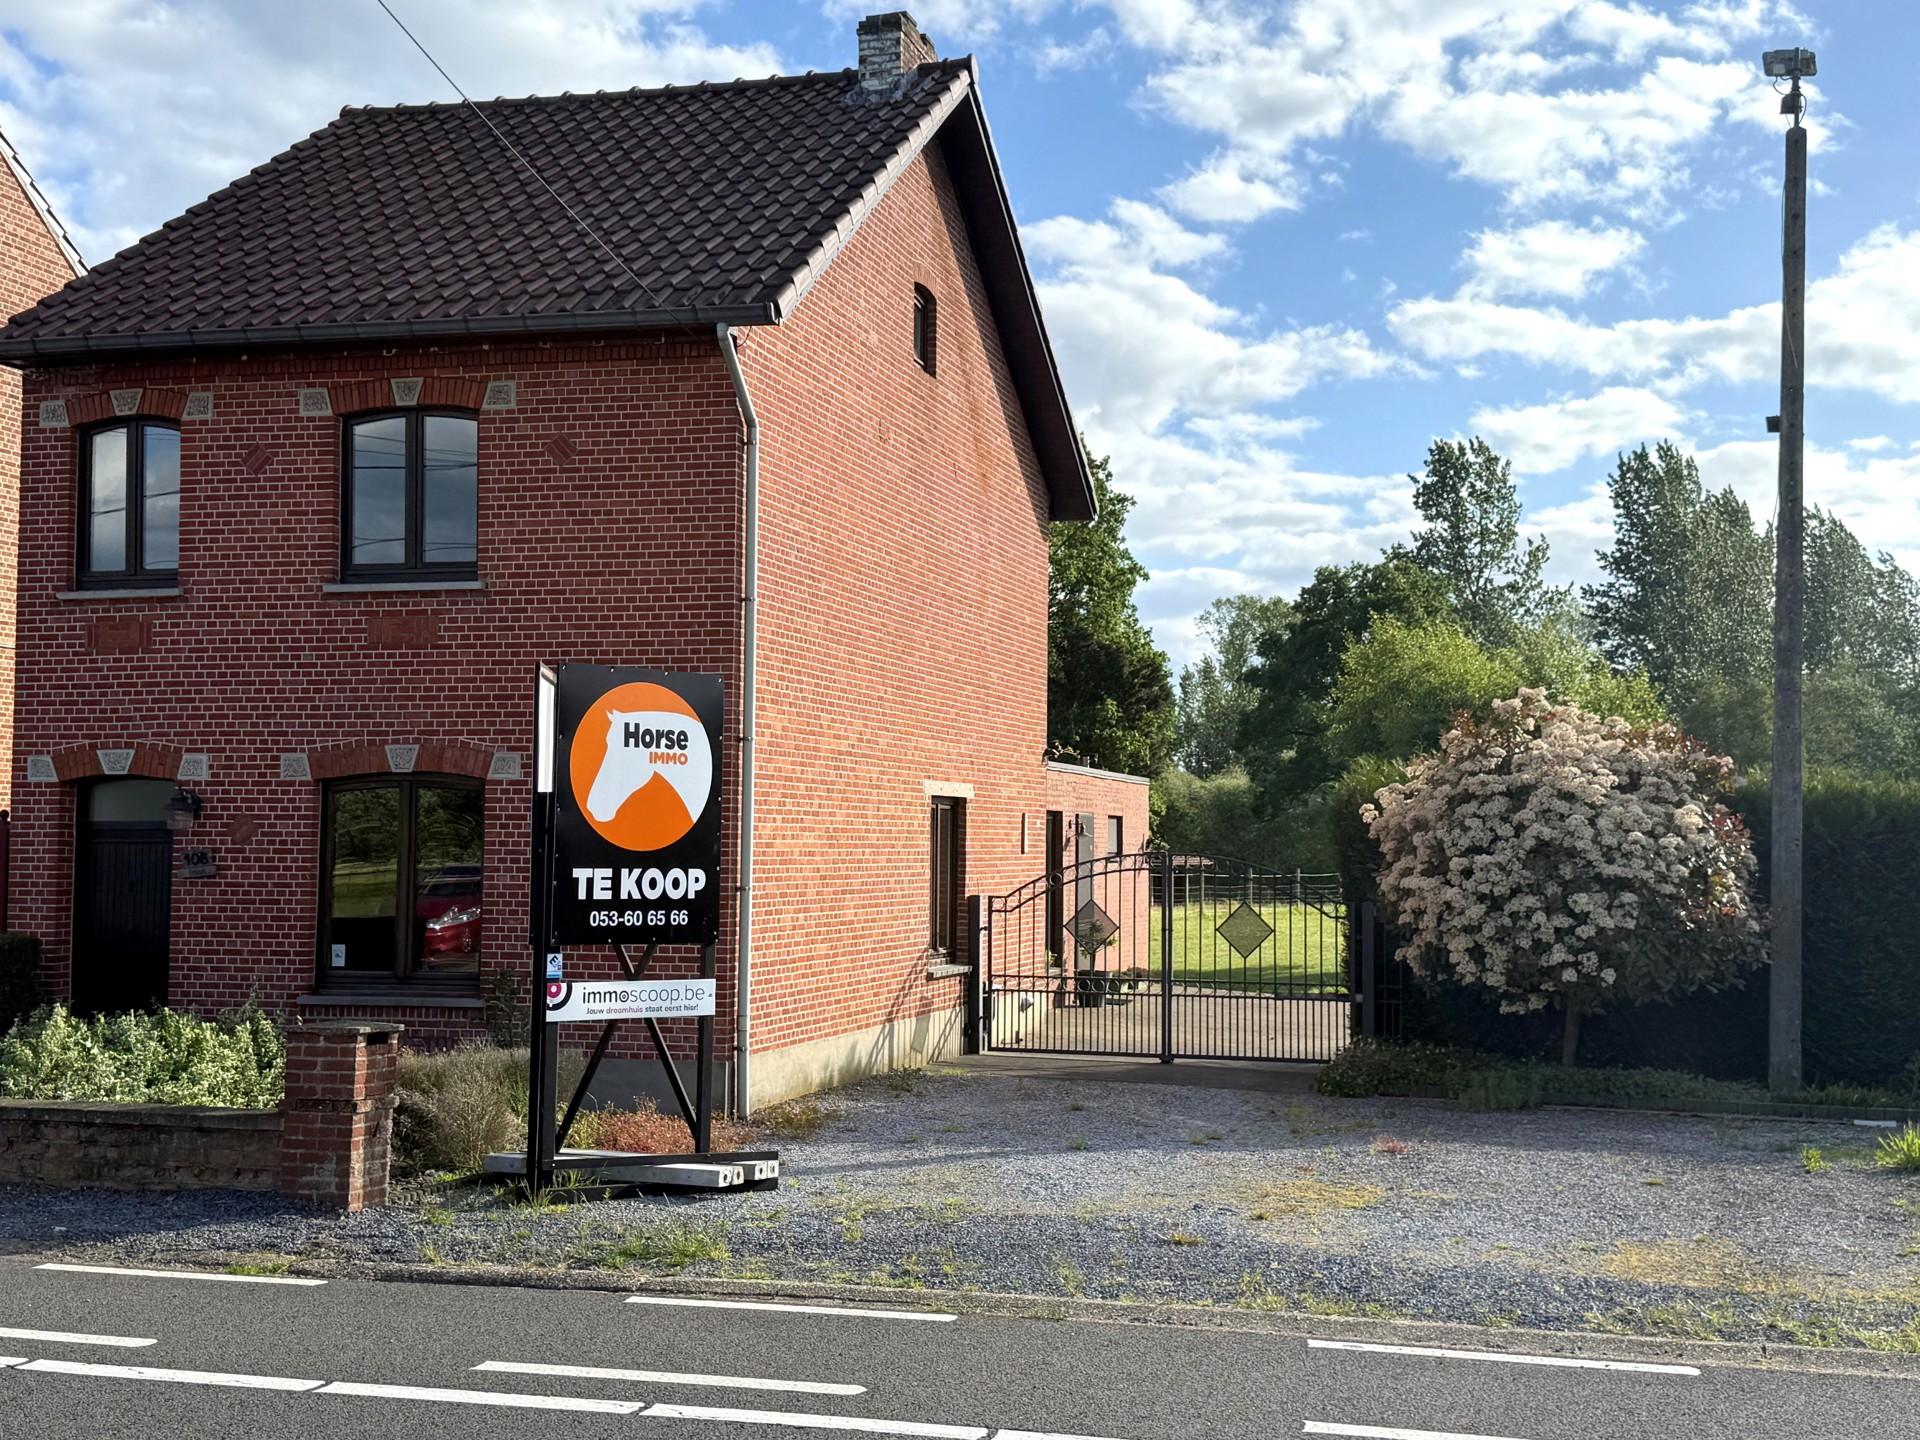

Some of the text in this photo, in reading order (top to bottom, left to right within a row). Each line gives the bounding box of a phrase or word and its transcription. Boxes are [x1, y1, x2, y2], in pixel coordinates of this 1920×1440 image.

[623, 722, 689, 751] Horse
[649, 751, 688, 766] IMMO
[572, 867, 707, 900] TE KOOP
[590, 909, 689, 927] 053-60 65 66
[582, 984, 705, 1005] immoscoop.be
[586, 1007, 605, 1015] Jouw
[606, 1005, 643, 1014] droomhuis
[644, 1005, 663, 1013] staat
